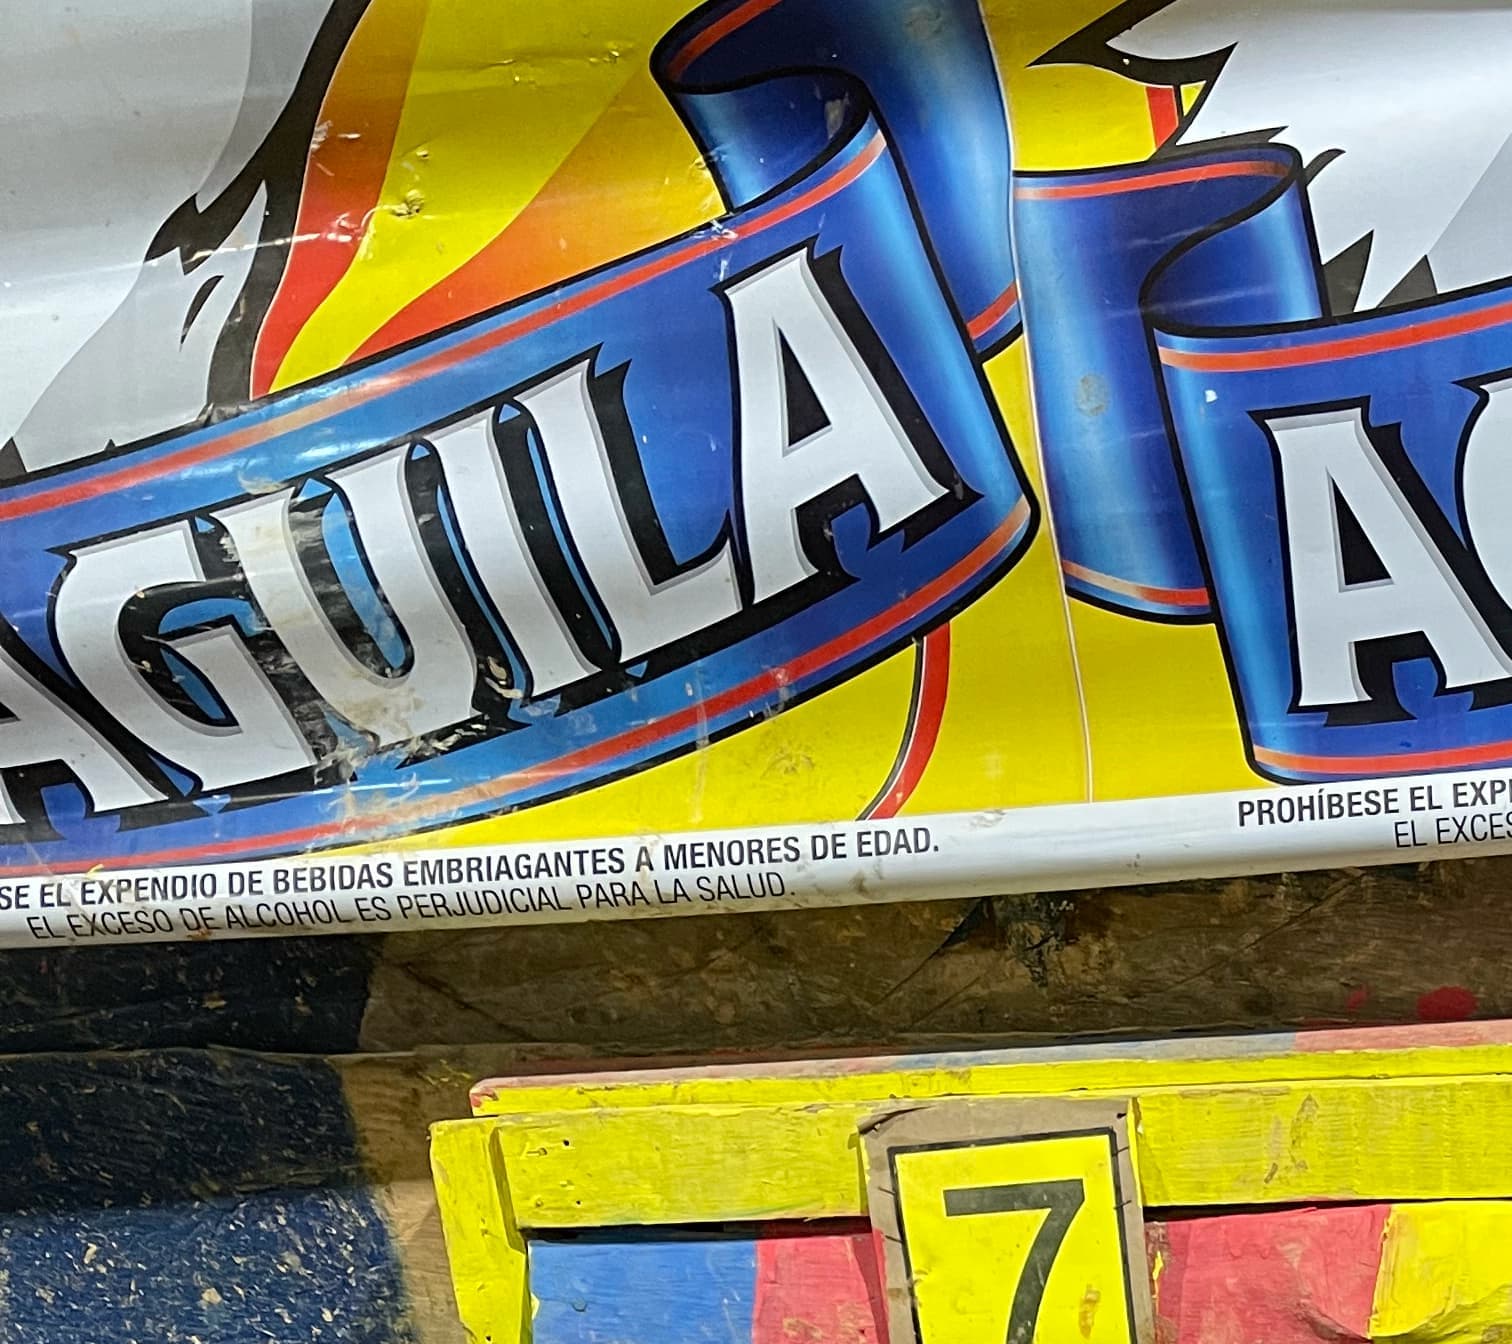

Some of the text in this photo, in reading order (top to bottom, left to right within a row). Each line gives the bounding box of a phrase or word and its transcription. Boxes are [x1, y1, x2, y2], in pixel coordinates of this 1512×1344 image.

[1238, 786, 1399, 827] PROHÍBESE
[1409, 785, 1443, 812] EL
[1394, 821, 1428, 848] EL
[40, 882, 70, 908] EL
[80, 872, 217, 906] EXPENDIO
[228, 870, 264, 897] DE
[273, 861, 393, 894] BEBIDAS
[403, 846, 624, 887] EMBRIAGANTES
[635, 849, 654, 873] A
[663, 835, 801, 871] MENORES
[811, 832, 848, 862] DE
[856, 826, 940, 858] EDAD.
[27, 869, 796, 940] EL EXCESO DE ALCOHOL ES PERJUDICIAL PARA LA SALUD.
